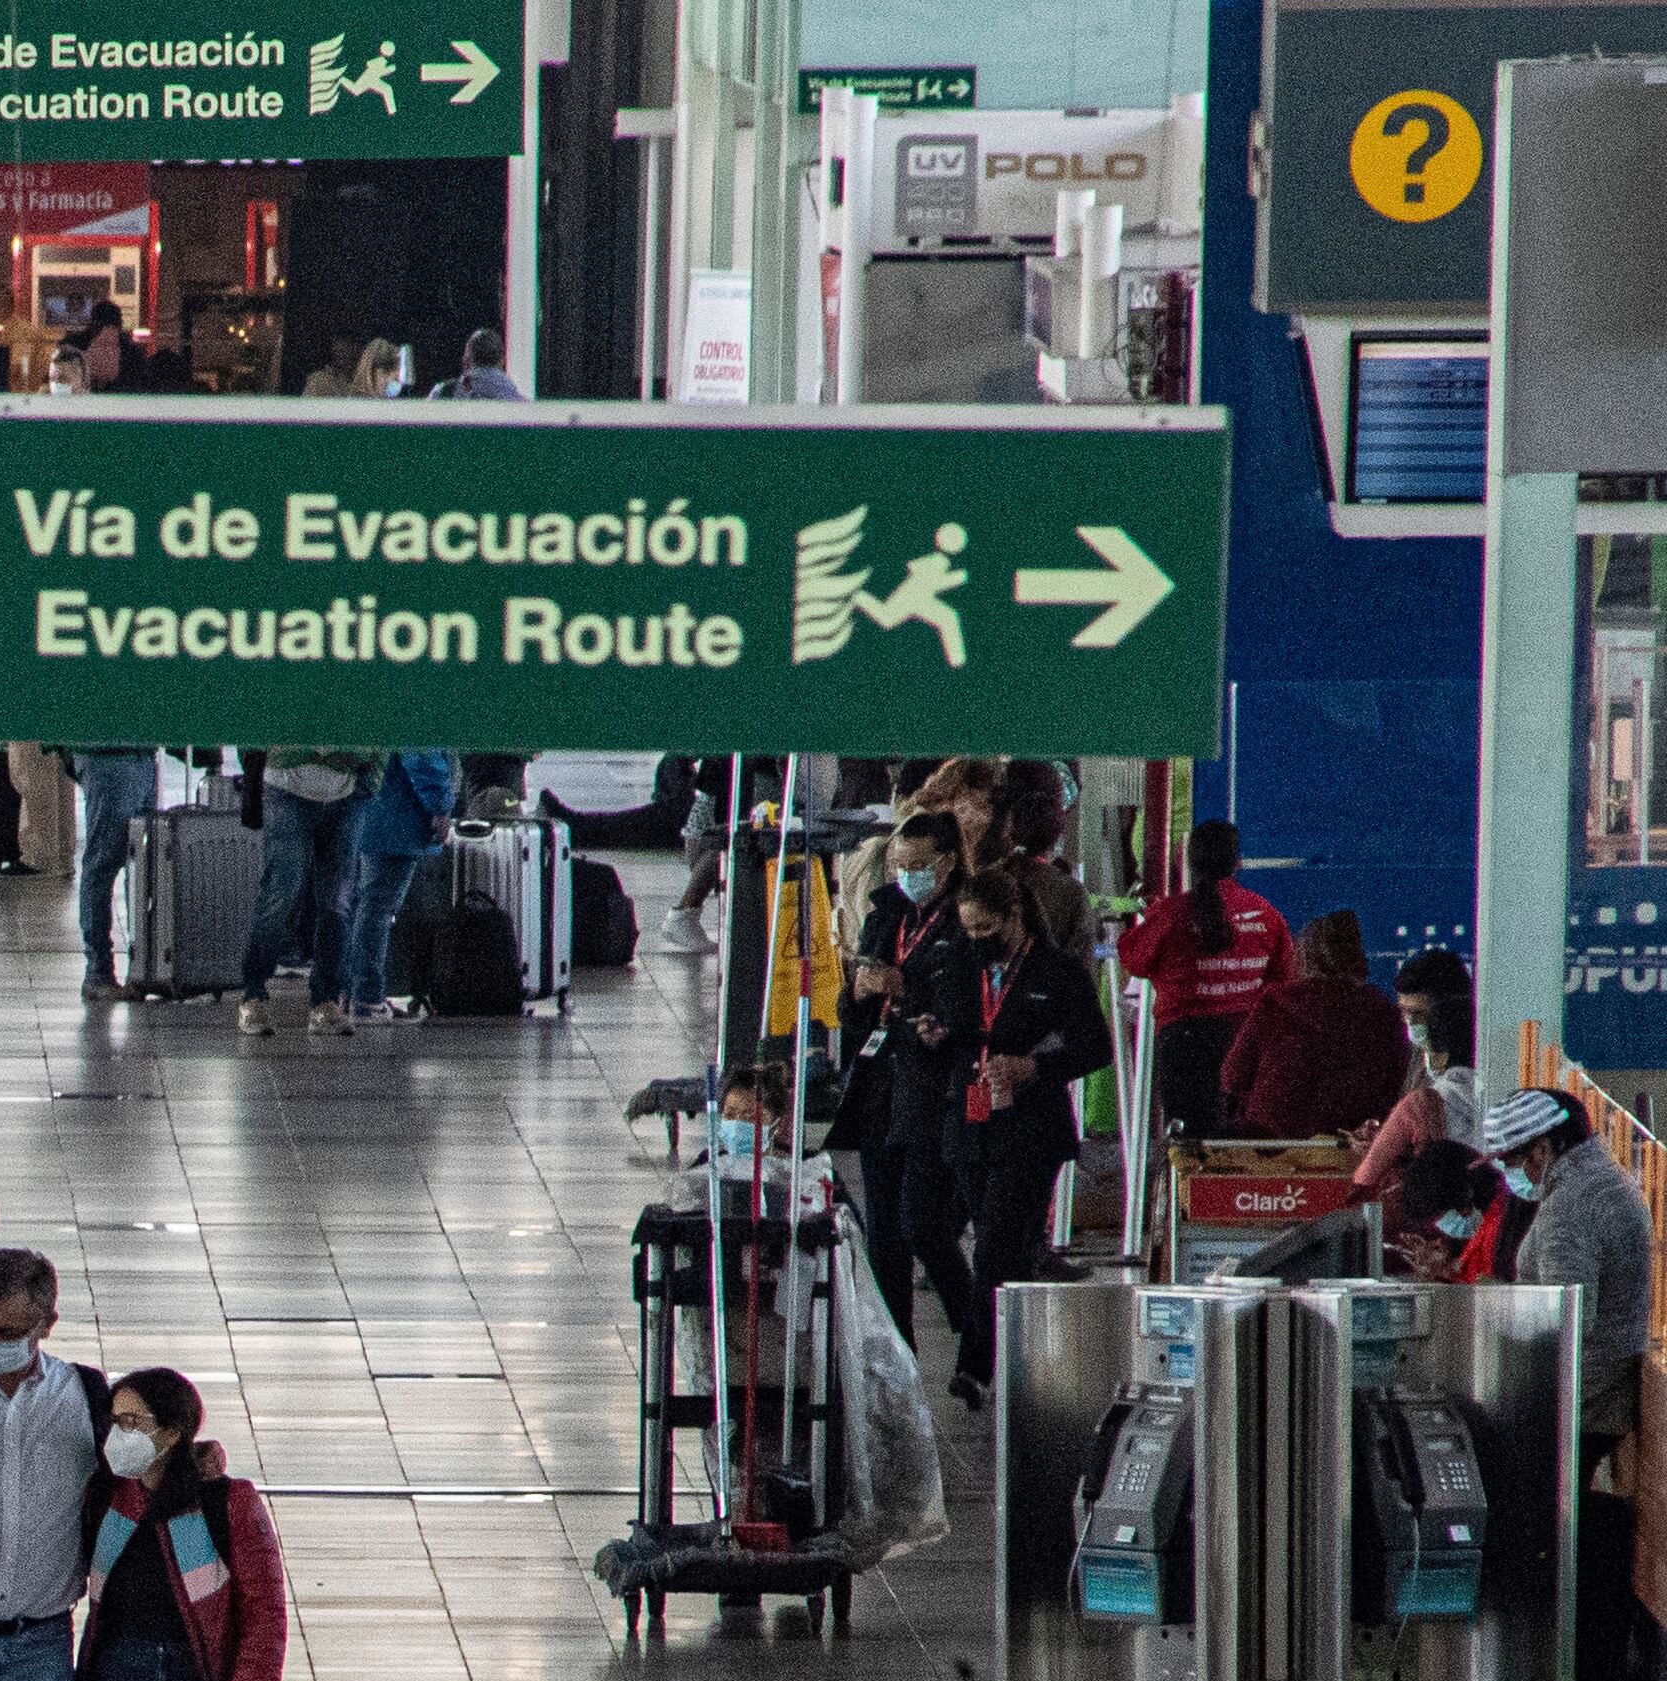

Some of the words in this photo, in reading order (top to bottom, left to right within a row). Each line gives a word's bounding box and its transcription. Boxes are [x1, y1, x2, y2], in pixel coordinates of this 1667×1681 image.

[51, 33, 285, 69] Evacuación
[164, 87, 285, 119] Route
[916, 151, 963, 170] UV
[985, 152, 1148, 181] POLO
[12, 194, 25, 214] y
[699, 340, 744, 361] CONTROL
[15, 490, 135, 557] Vía
[160, 492, 260, 560] de
[285, 494, 749, 567] Evacuación
[37, 590, 478, 664] Evacuation
[504, 597, 744, 669] Route
[1233, 1186, 1299, 1212] Claro
